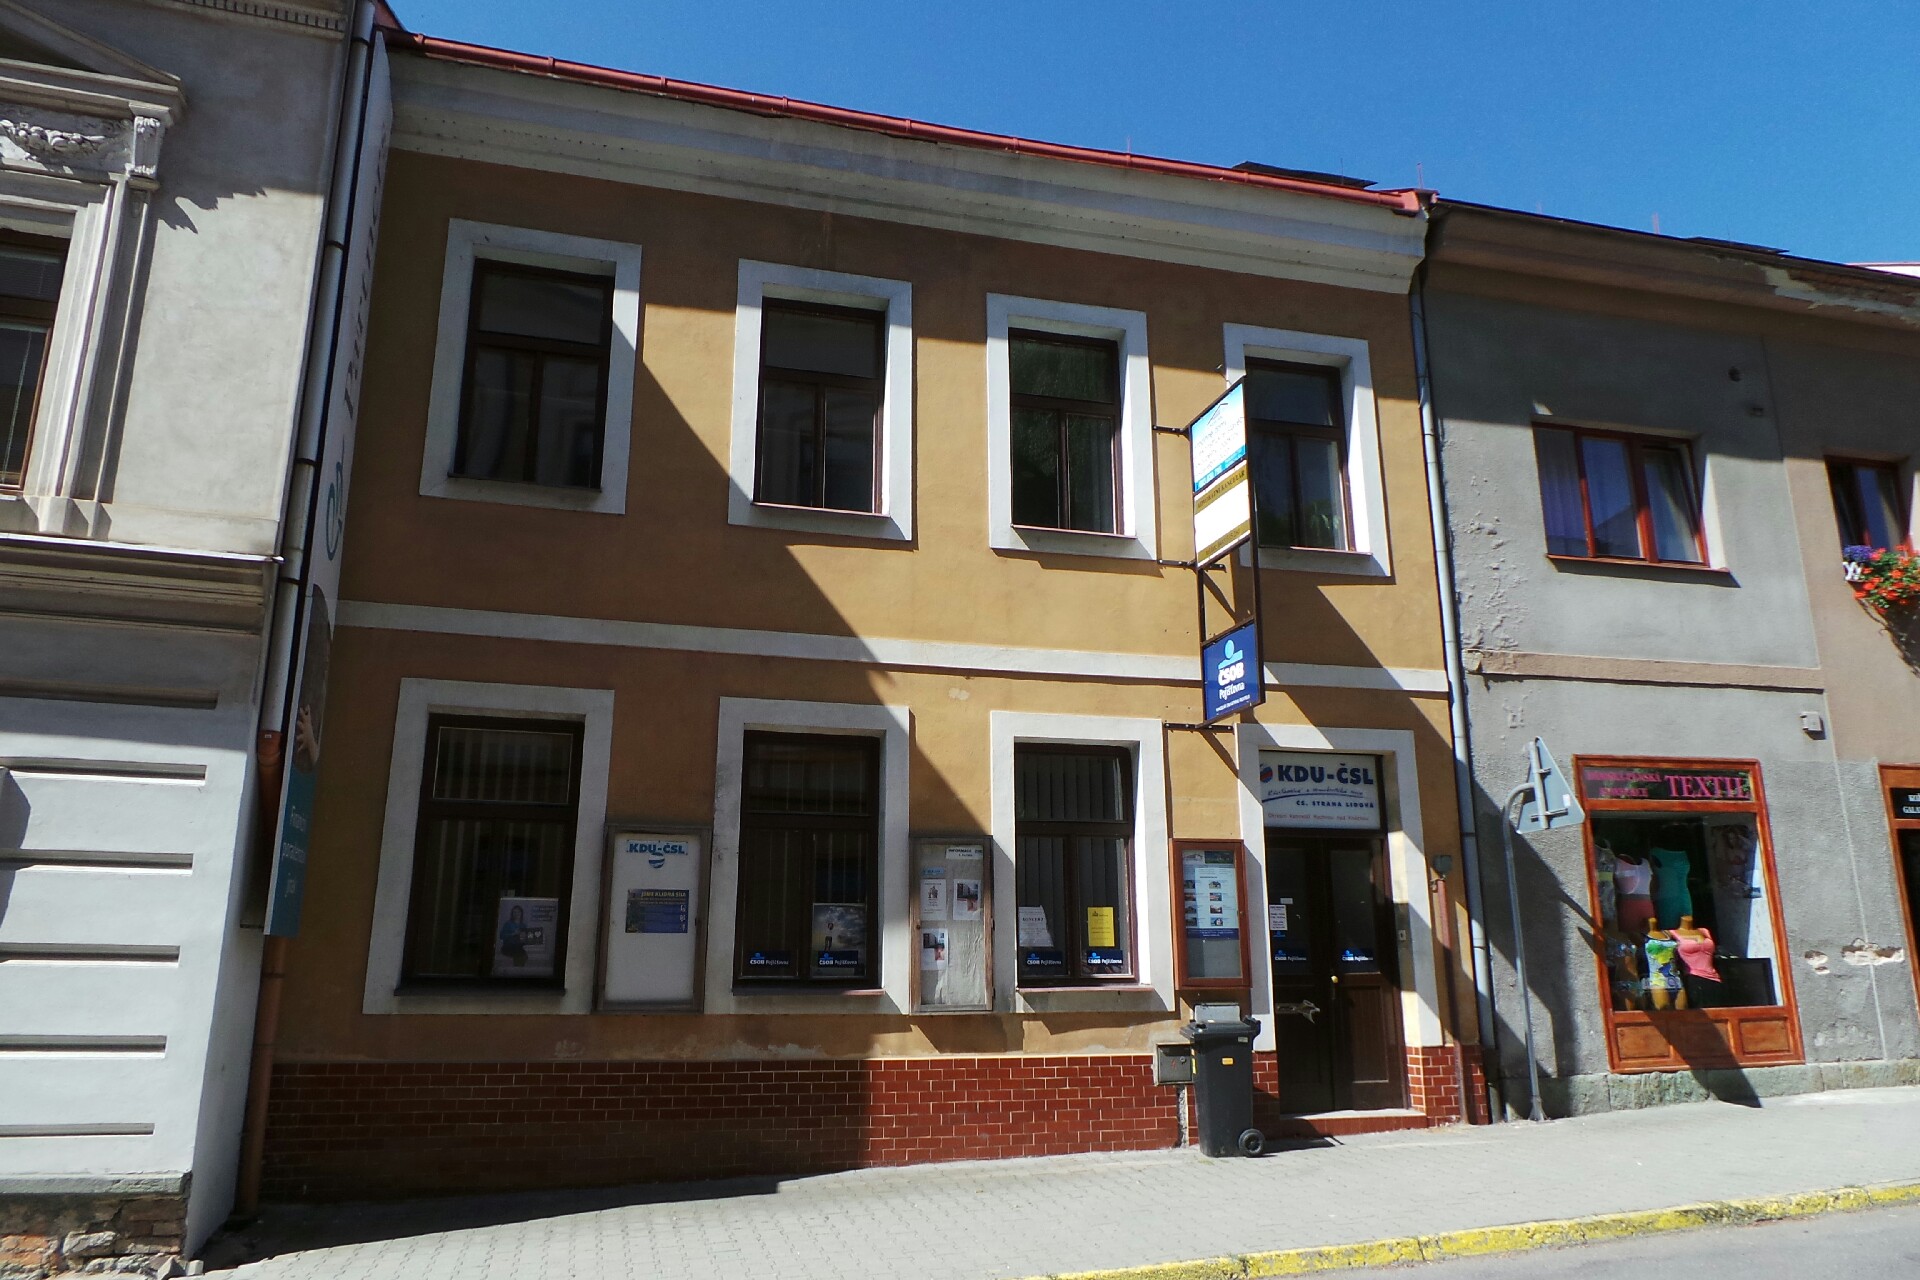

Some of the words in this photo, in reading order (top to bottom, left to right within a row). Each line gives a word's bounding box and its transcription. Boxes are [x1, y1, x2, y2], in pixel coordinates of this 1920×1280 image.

[1217, 661, 1244, 686] ČSOB
[1218, 682, 1245, 700] Pojišťovna
[1277, 763, 1374, 785] KDU-ČSL
[1665, 775, 1751, 799] TEXTIL
[629, 842, 686, 854] KDU-ČSL
